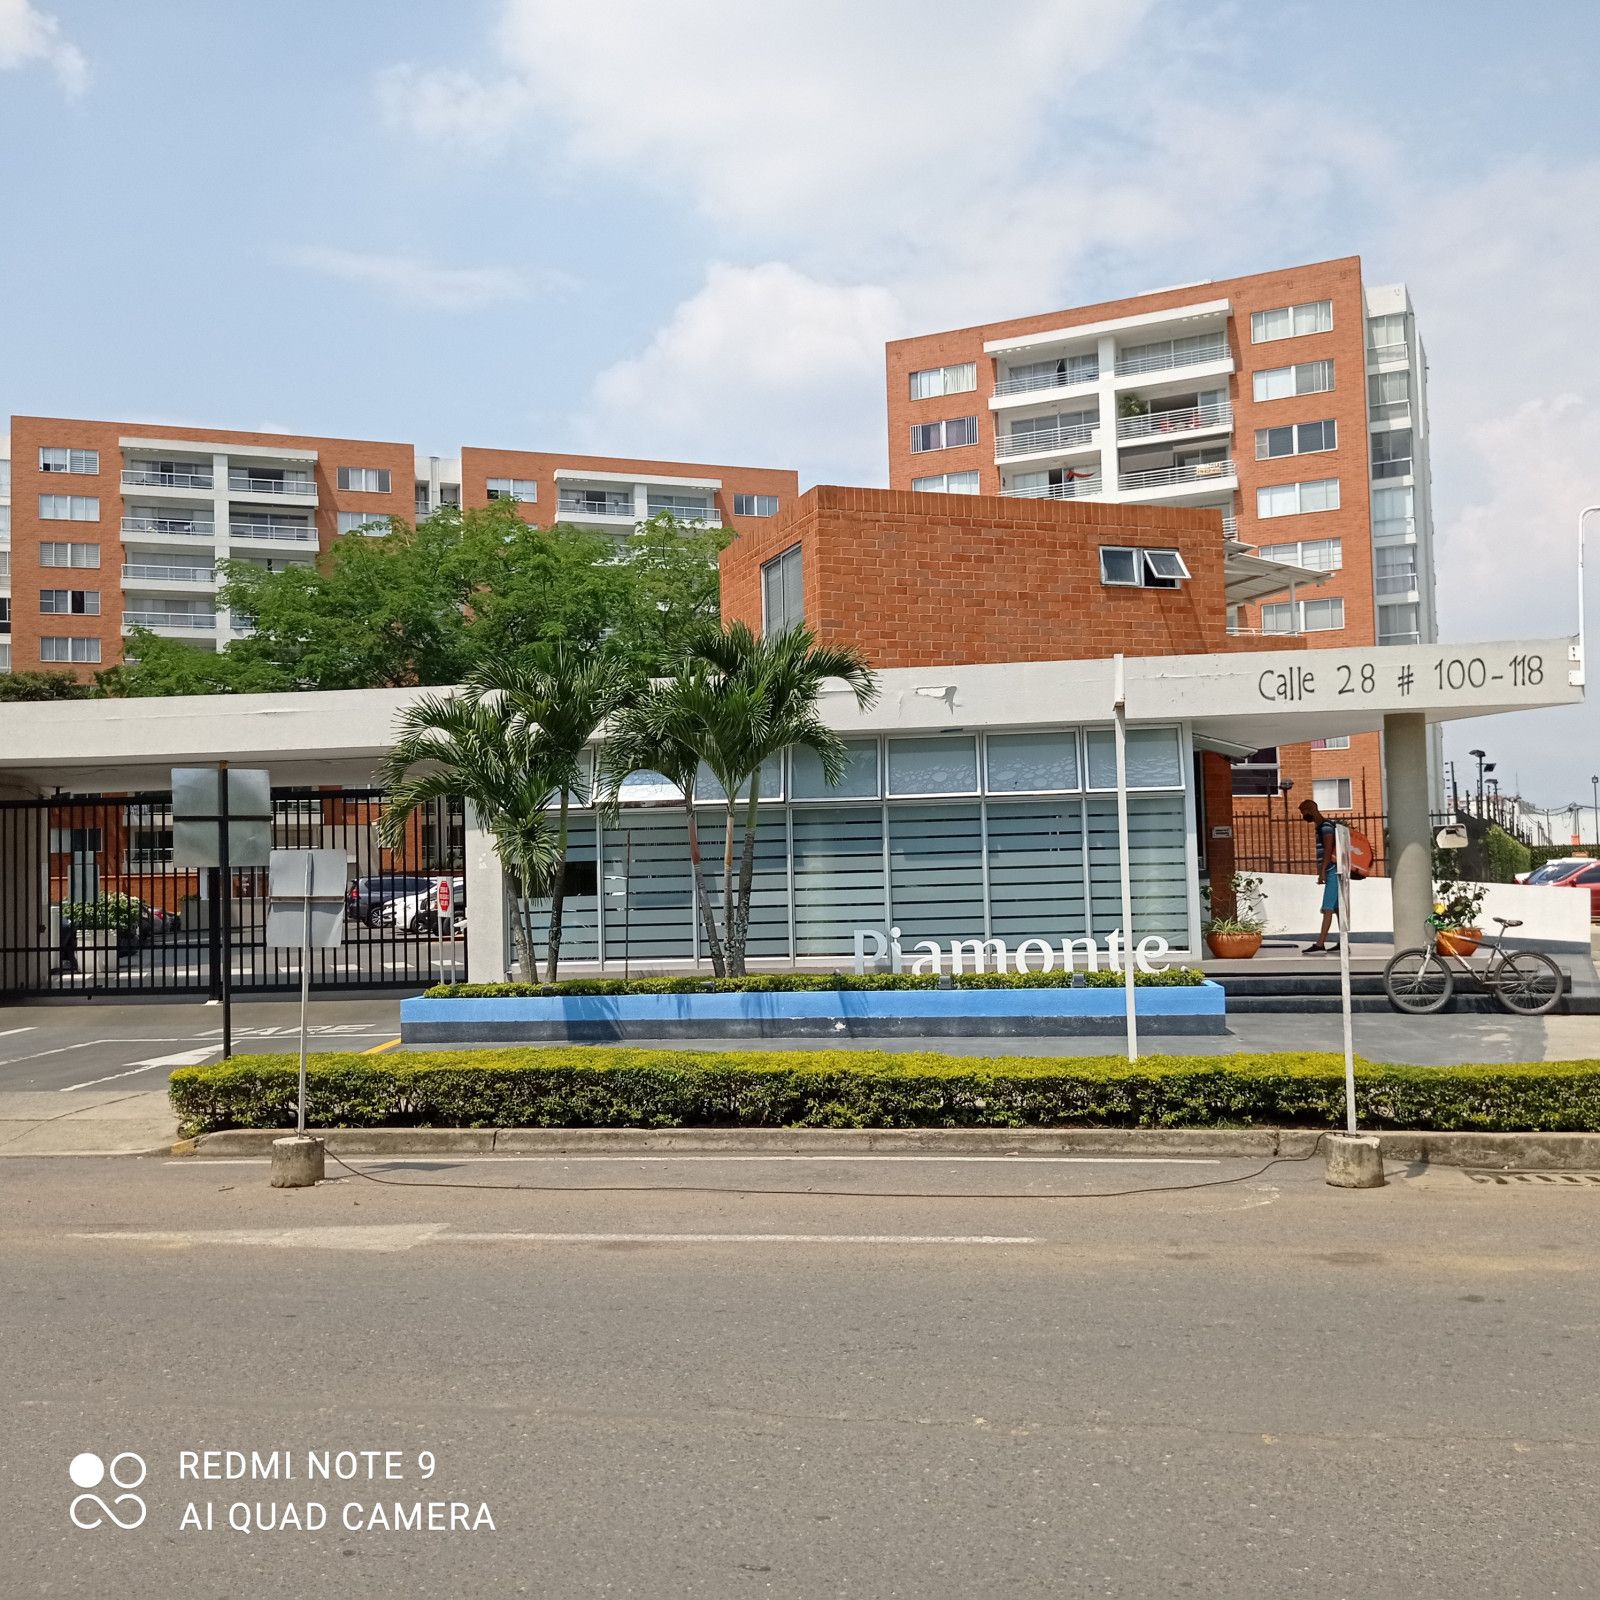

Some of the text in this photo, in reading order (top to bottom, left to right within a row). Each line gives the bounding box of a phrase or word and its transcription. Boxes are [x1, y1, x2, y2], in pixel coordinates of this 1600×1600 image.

[1258, 654, 1544, 701] Calle 28 # 100-118
[853, 927, 1171, 975] Piamonte
